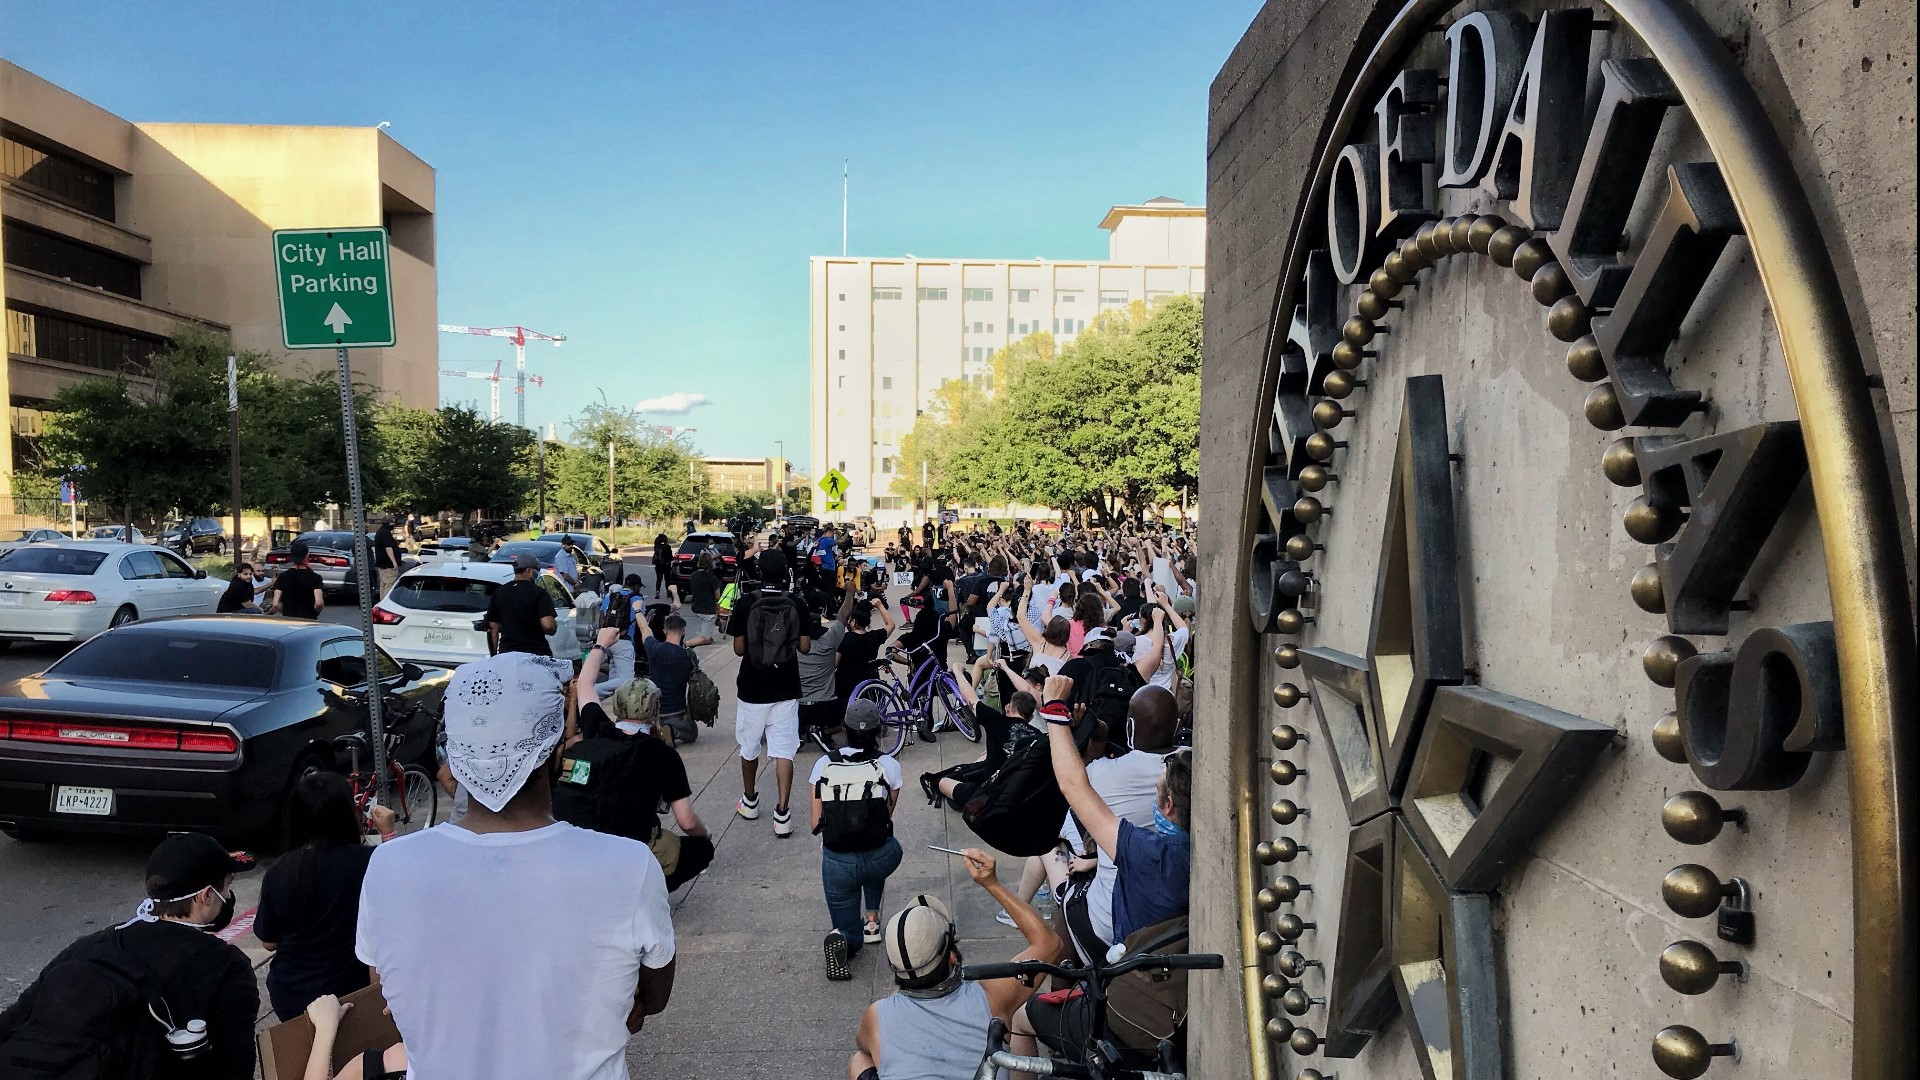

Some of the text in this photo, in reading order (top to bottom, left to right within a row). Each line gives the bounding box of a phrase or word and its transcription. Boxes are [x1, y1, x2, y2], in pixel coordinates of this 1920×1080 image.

[281, 240, 382, 267] City Hall
[290, 272, 378, 296] Parking
[1328, 68, 1442, 285] OF
[1438, 5, 1845, 791] DALLAS
